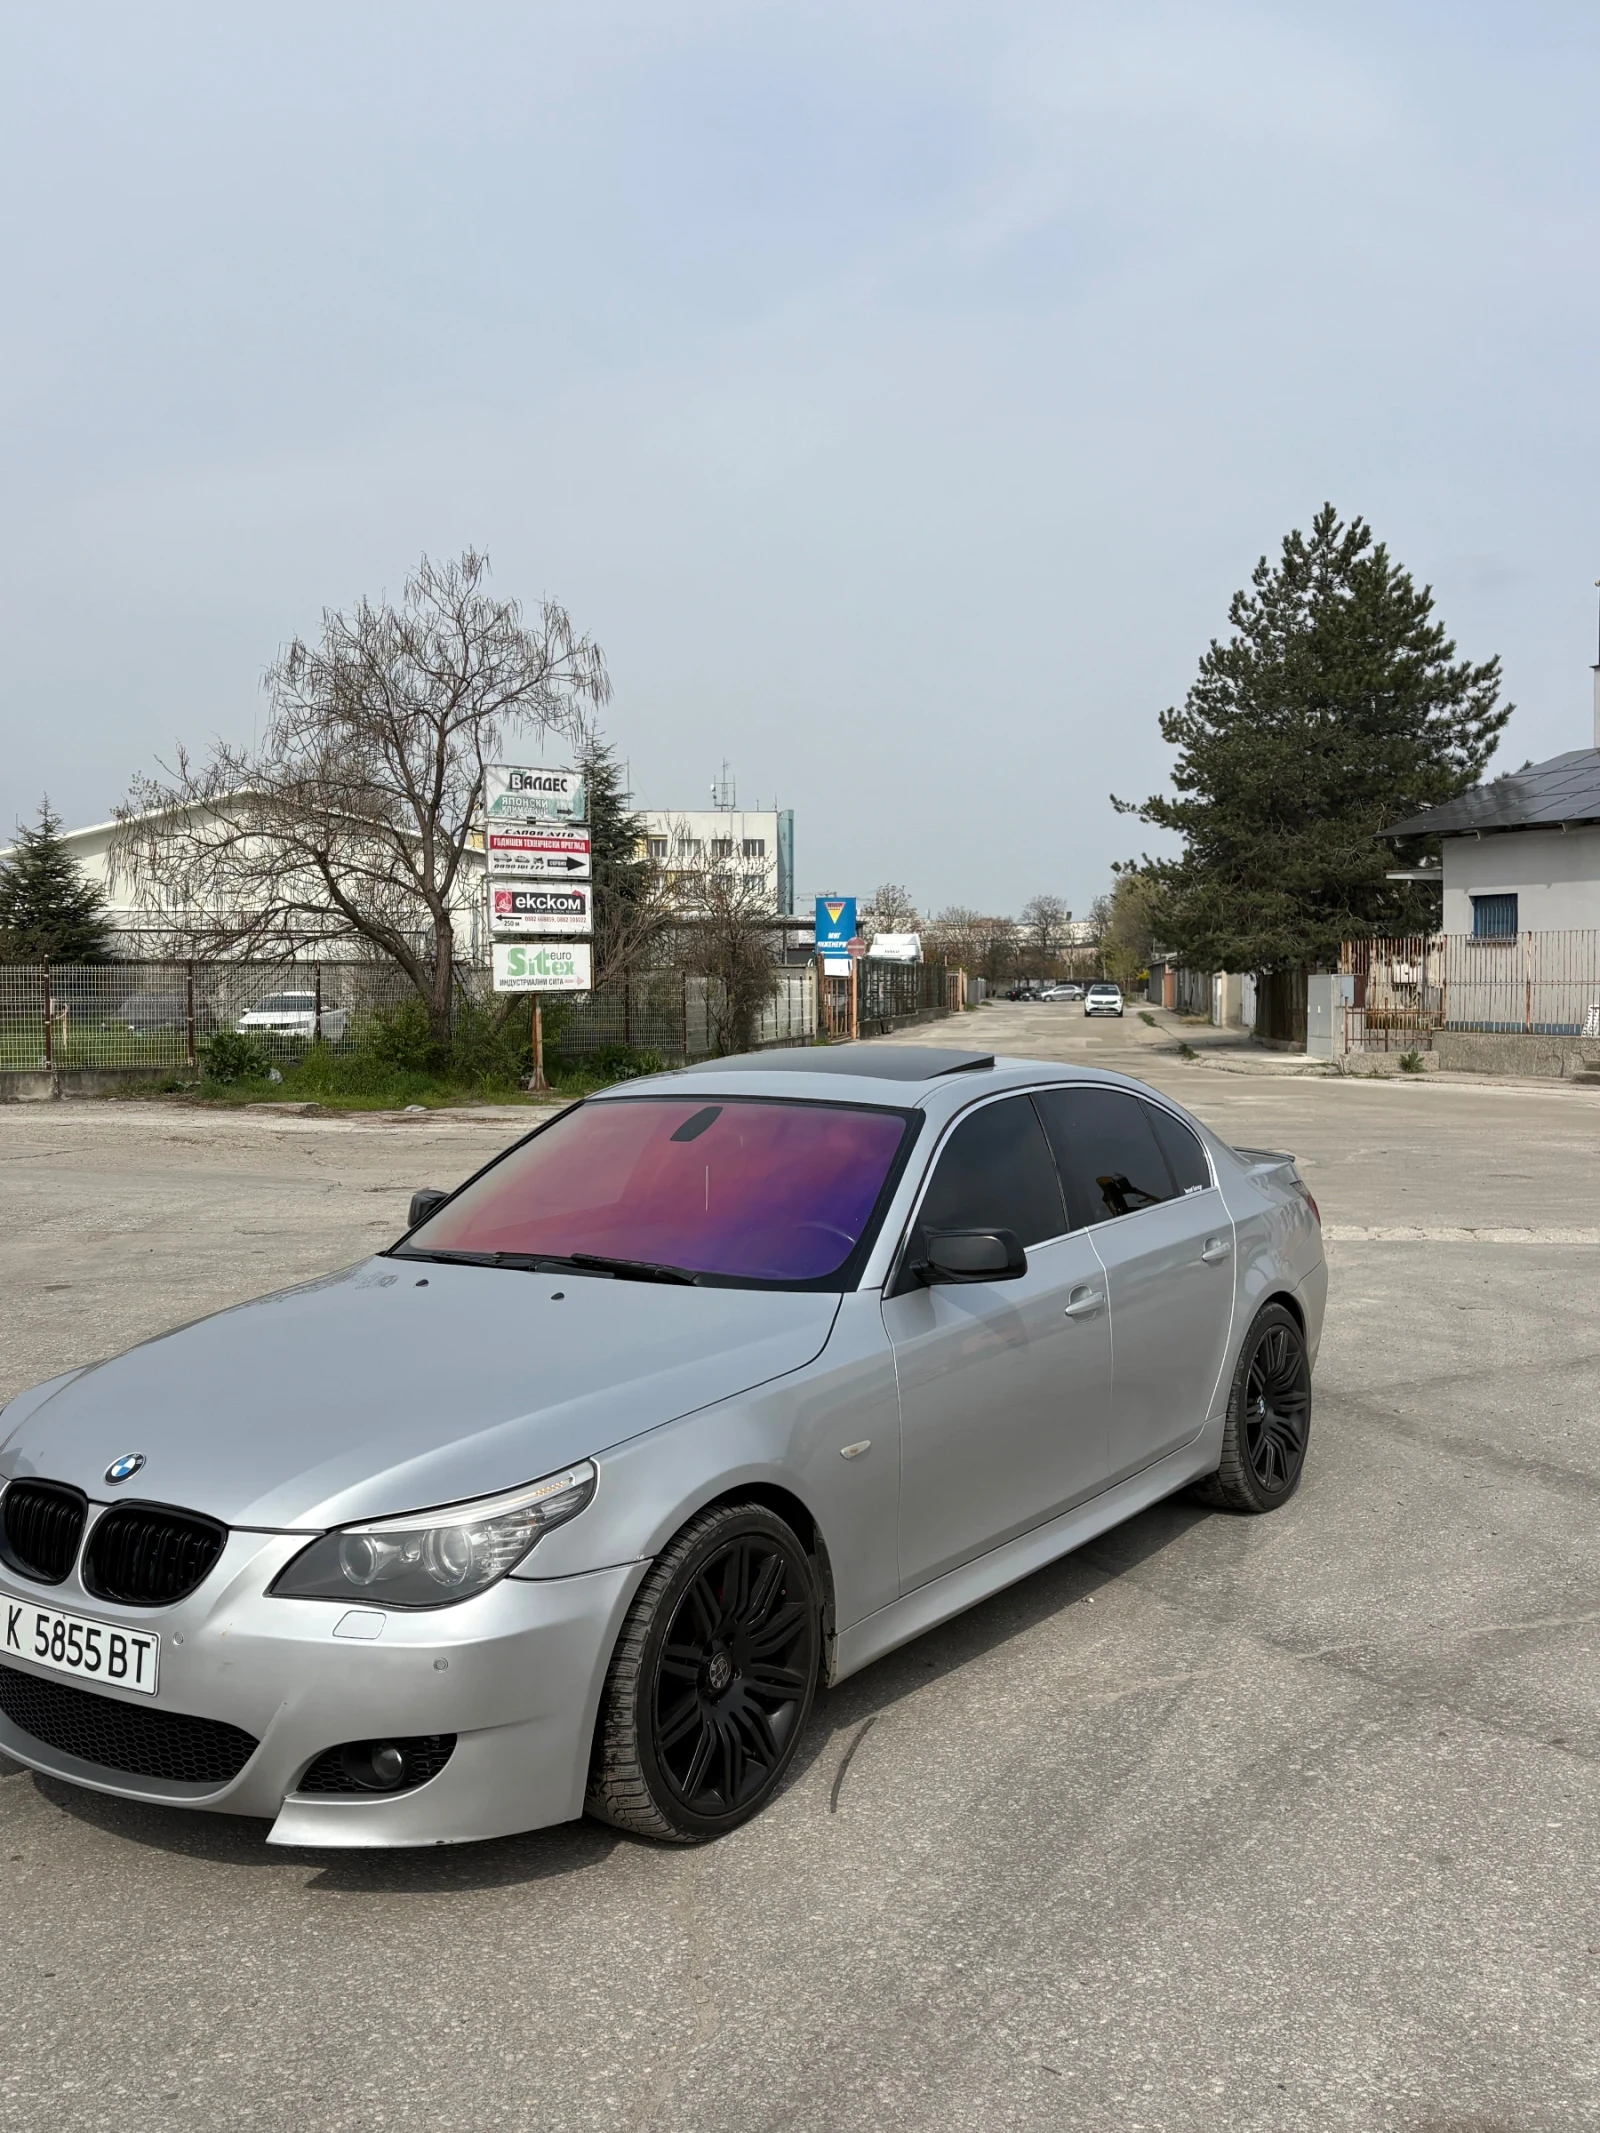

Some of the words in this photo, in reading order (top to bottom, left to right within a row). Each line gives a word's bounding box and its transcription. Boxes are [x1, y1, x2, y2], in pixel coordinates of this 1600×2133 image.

[509, 772, 568, 793] ВАЛДЕС
[501, 796, 548, 809] ЯПОНСКИ
[493, 837, 523, 848] ГОДИШЕН
[524, 838, 560, 849] ТЕХНИЧЕСКИ
[560, 840, 586, 852] ПРЕГЛЕД
[507, 947, 576, 977] Sitex
[550, 951, 572, 961] euro
[499, 978, 548, 988] ИНДУСТРИАЛНИ
[548, 978, 564, 986] СИТА
[6, 1604, 23, 1650] K
[34, 1613, 102, 1672] 5855
[107, 1632, 151, 1684] BT
